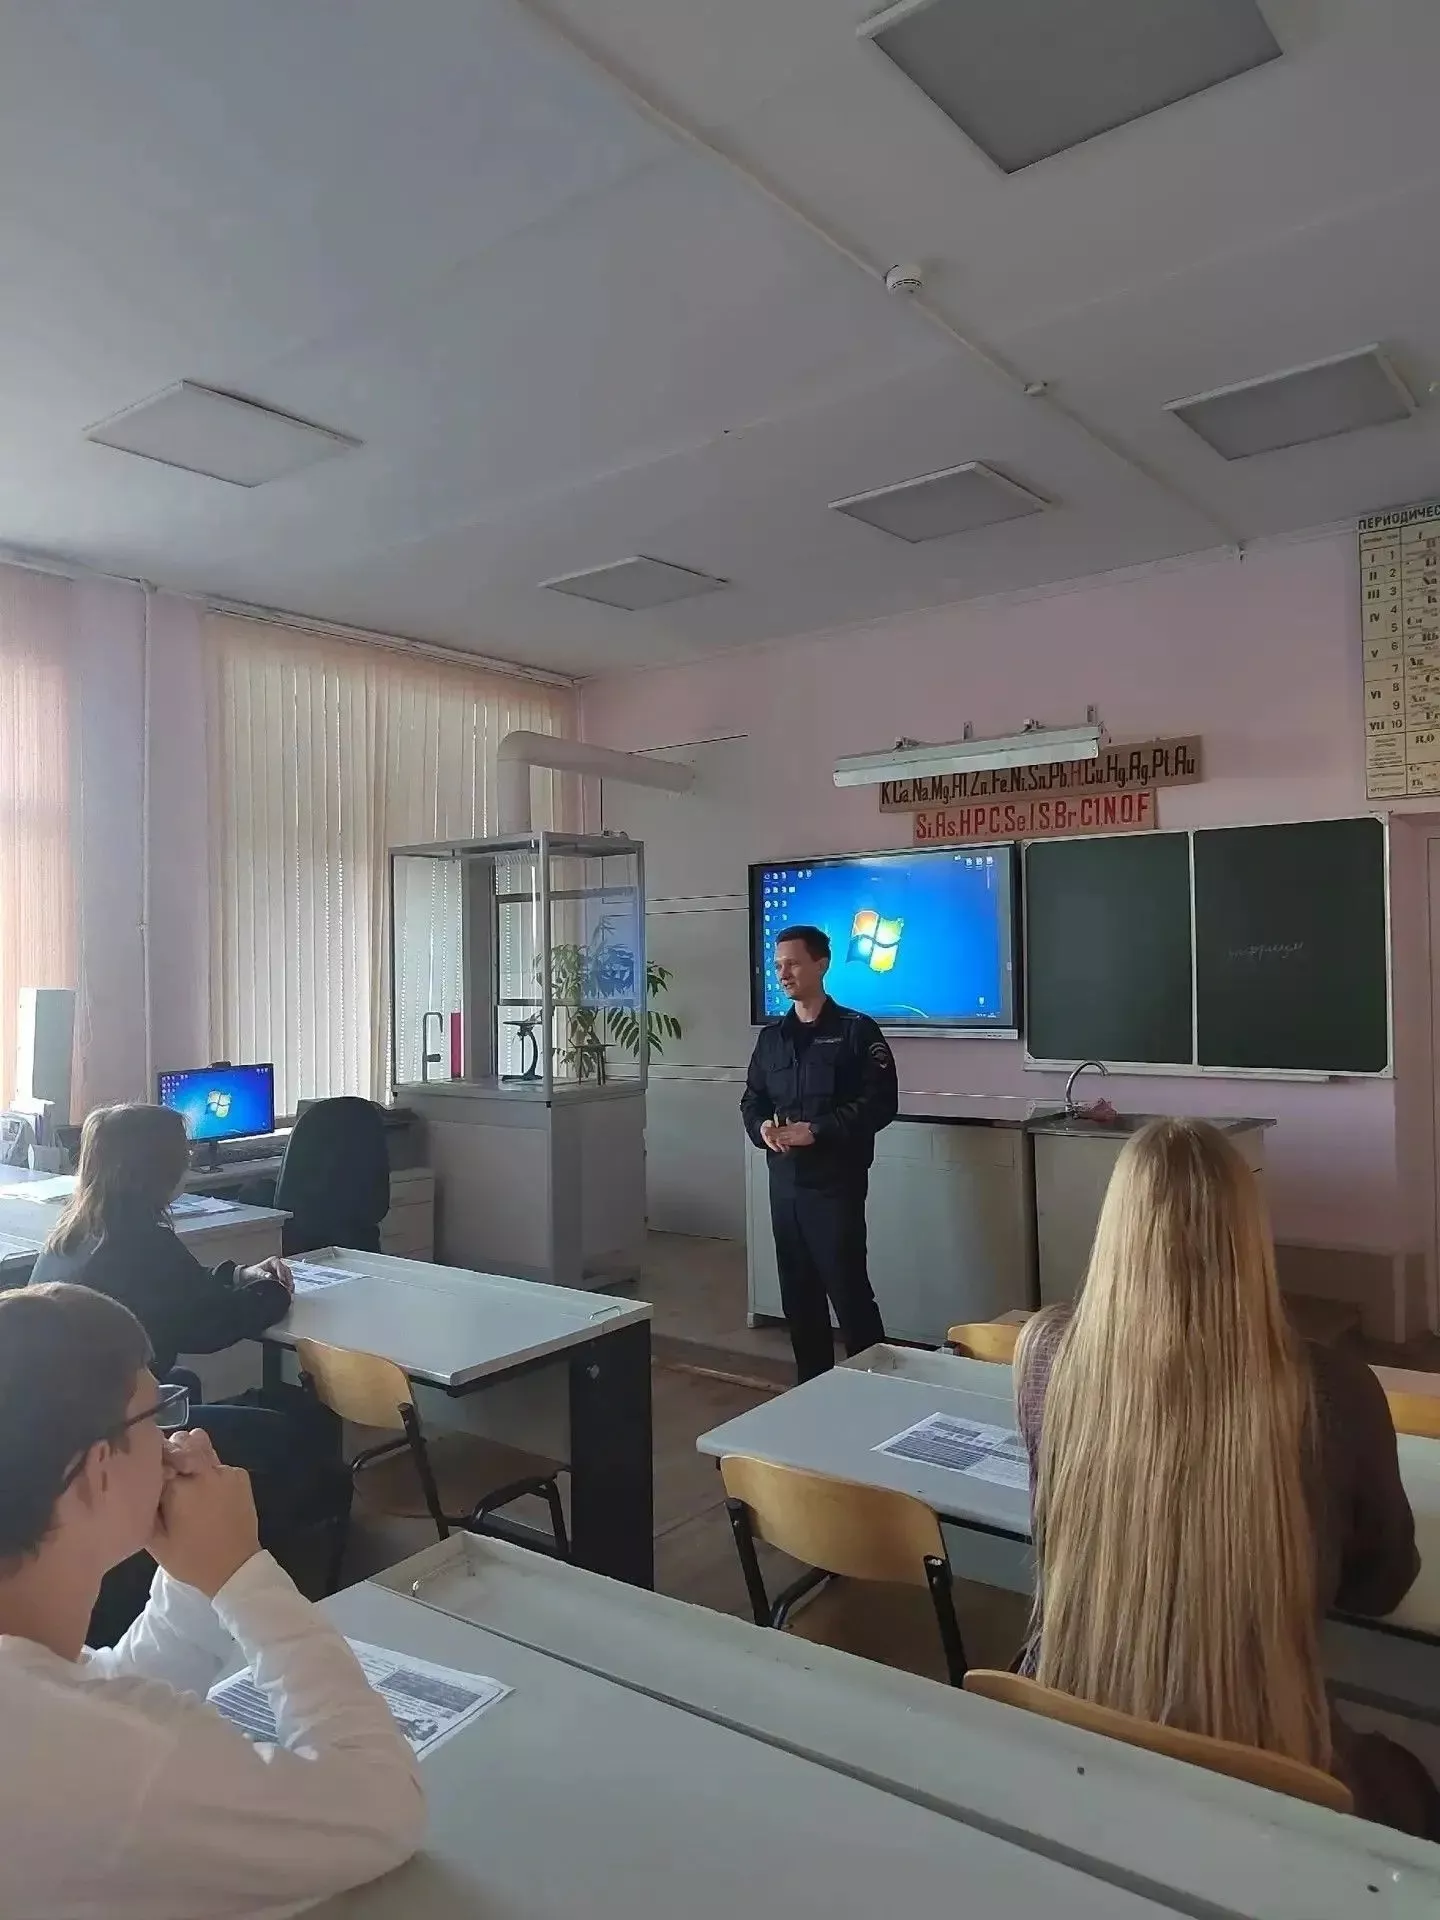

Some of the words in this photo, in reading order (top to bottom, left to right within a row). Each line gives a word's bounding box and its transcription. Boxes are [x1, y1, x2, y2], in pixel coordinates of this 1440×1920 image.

[1389, 568, 1396, 578] 2
[1390, 586, 1397, 596] 3
[1390, 605, 1397, 614] 4
[1391, 622, 1398, 632] 5
[1391, 641, 1399, 651] 6
[1391, 663, 1398, 673] 7
[1392, 682, 1400, 692] 8
[1392, 700, 1400, 710] 9
[1391, 719, 1403, 729] 10
